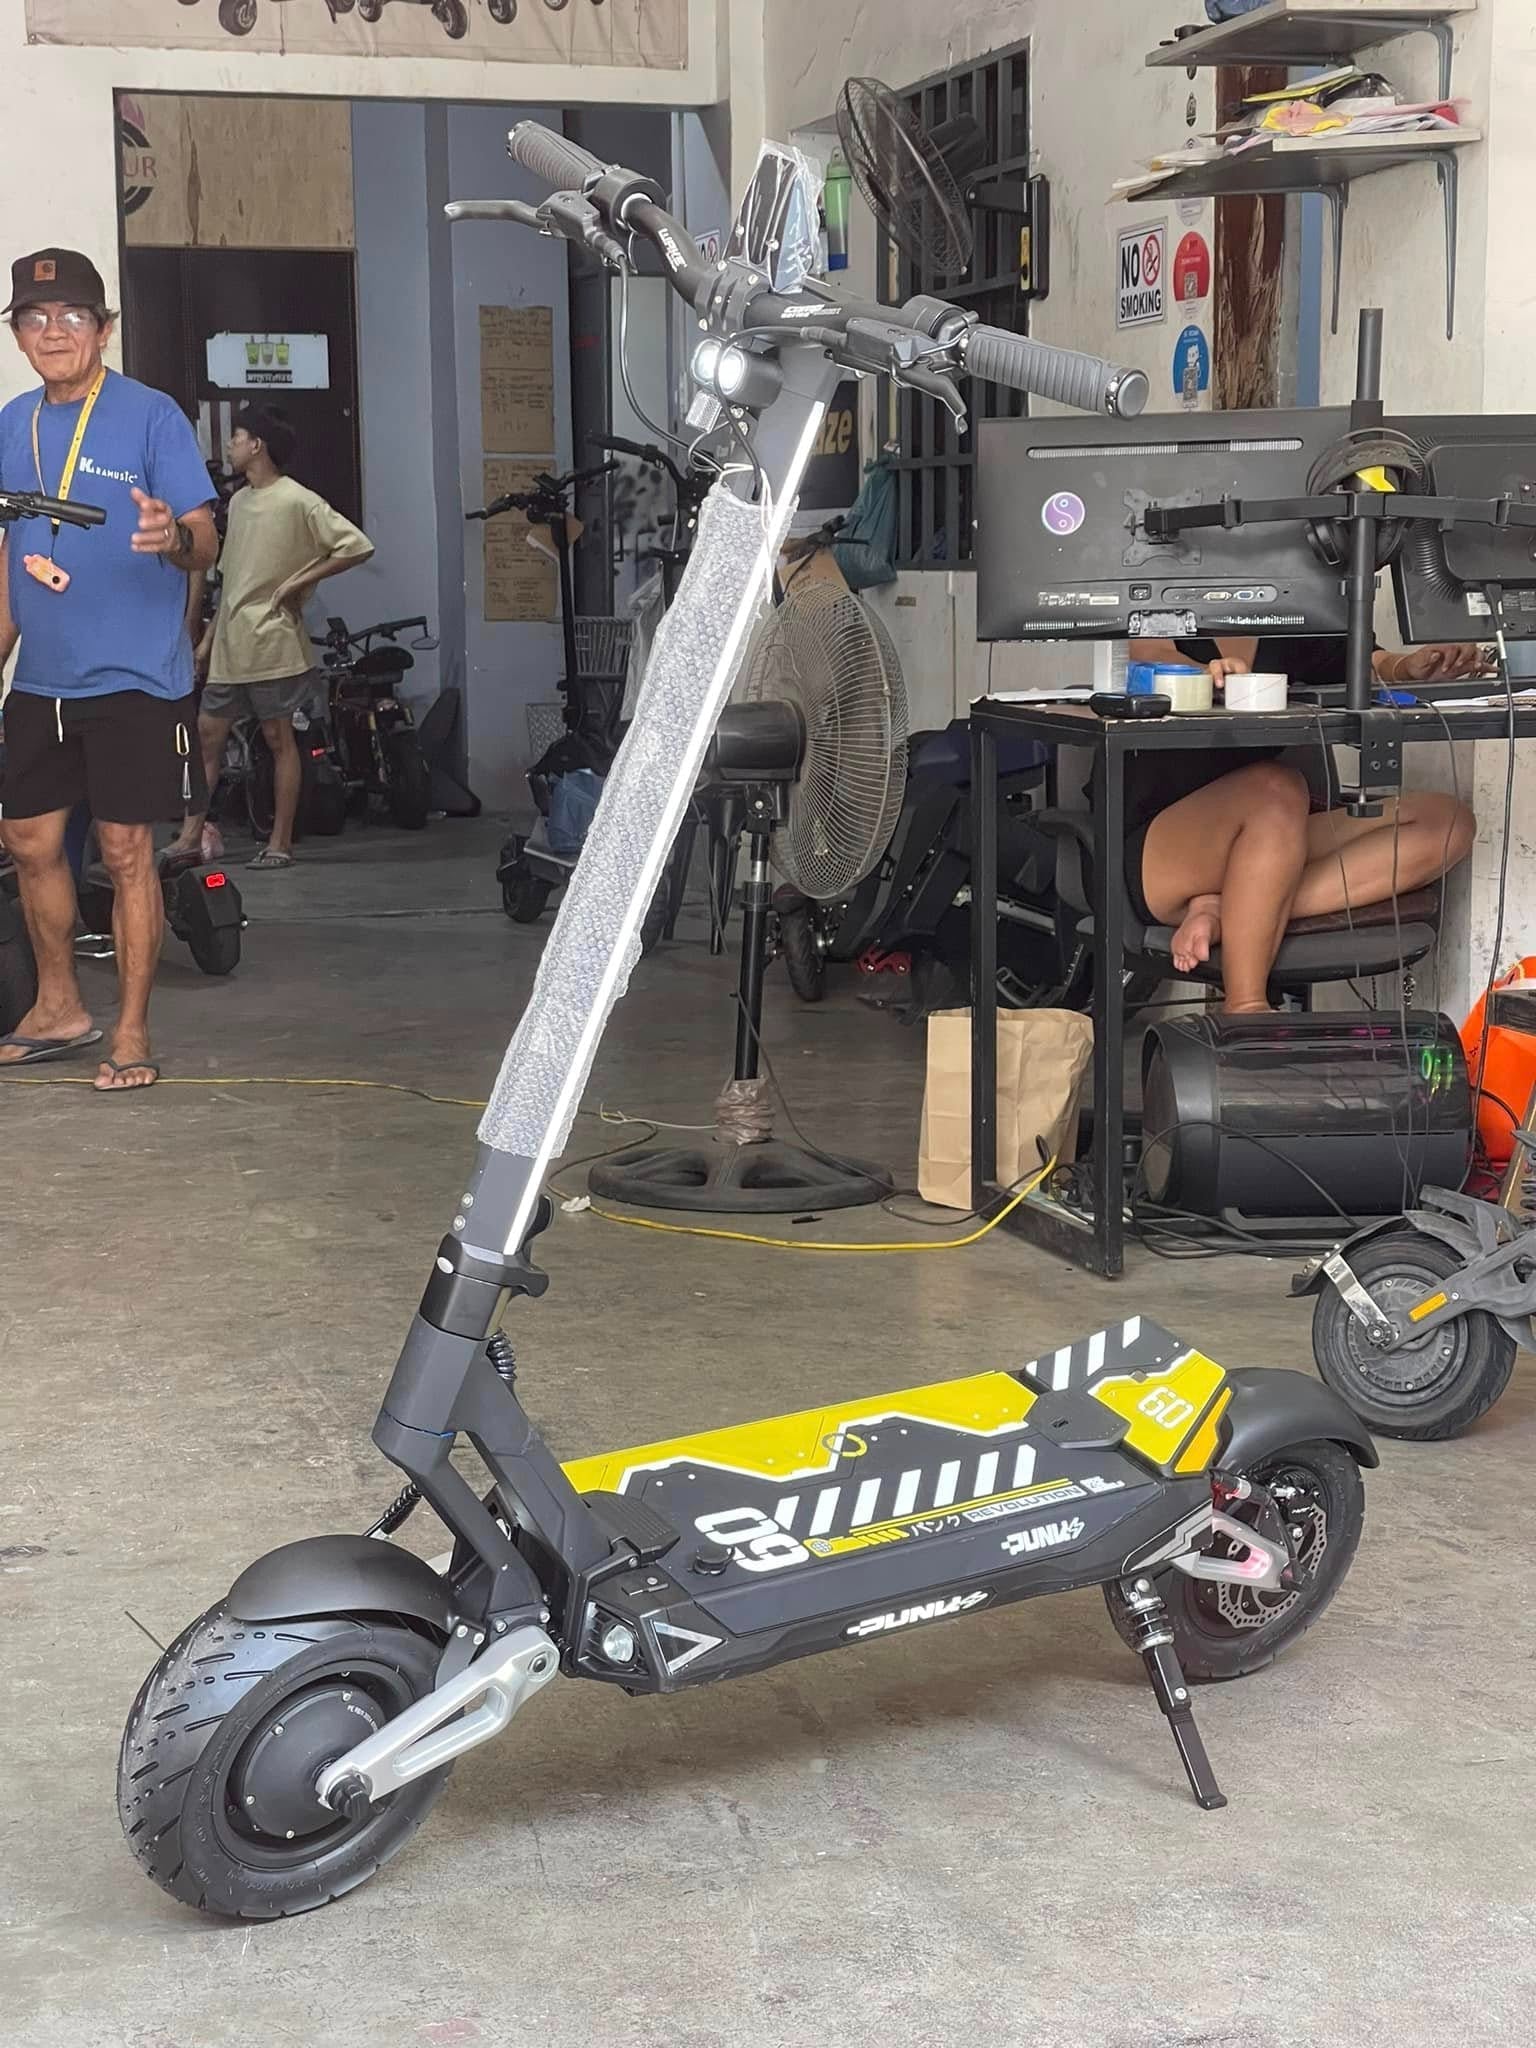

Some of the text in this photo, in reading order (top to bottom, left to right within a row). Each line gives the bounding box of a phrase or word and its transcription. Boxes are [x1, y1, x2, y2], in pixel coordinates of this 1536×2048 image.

[1121, 243, 1140, 290] NO
[1121, 289, 1162, 319] SMOKING
[1137, 1386, 1194, 1429] 60
[967, 1486, 1083, 1520] REVOLUTION
